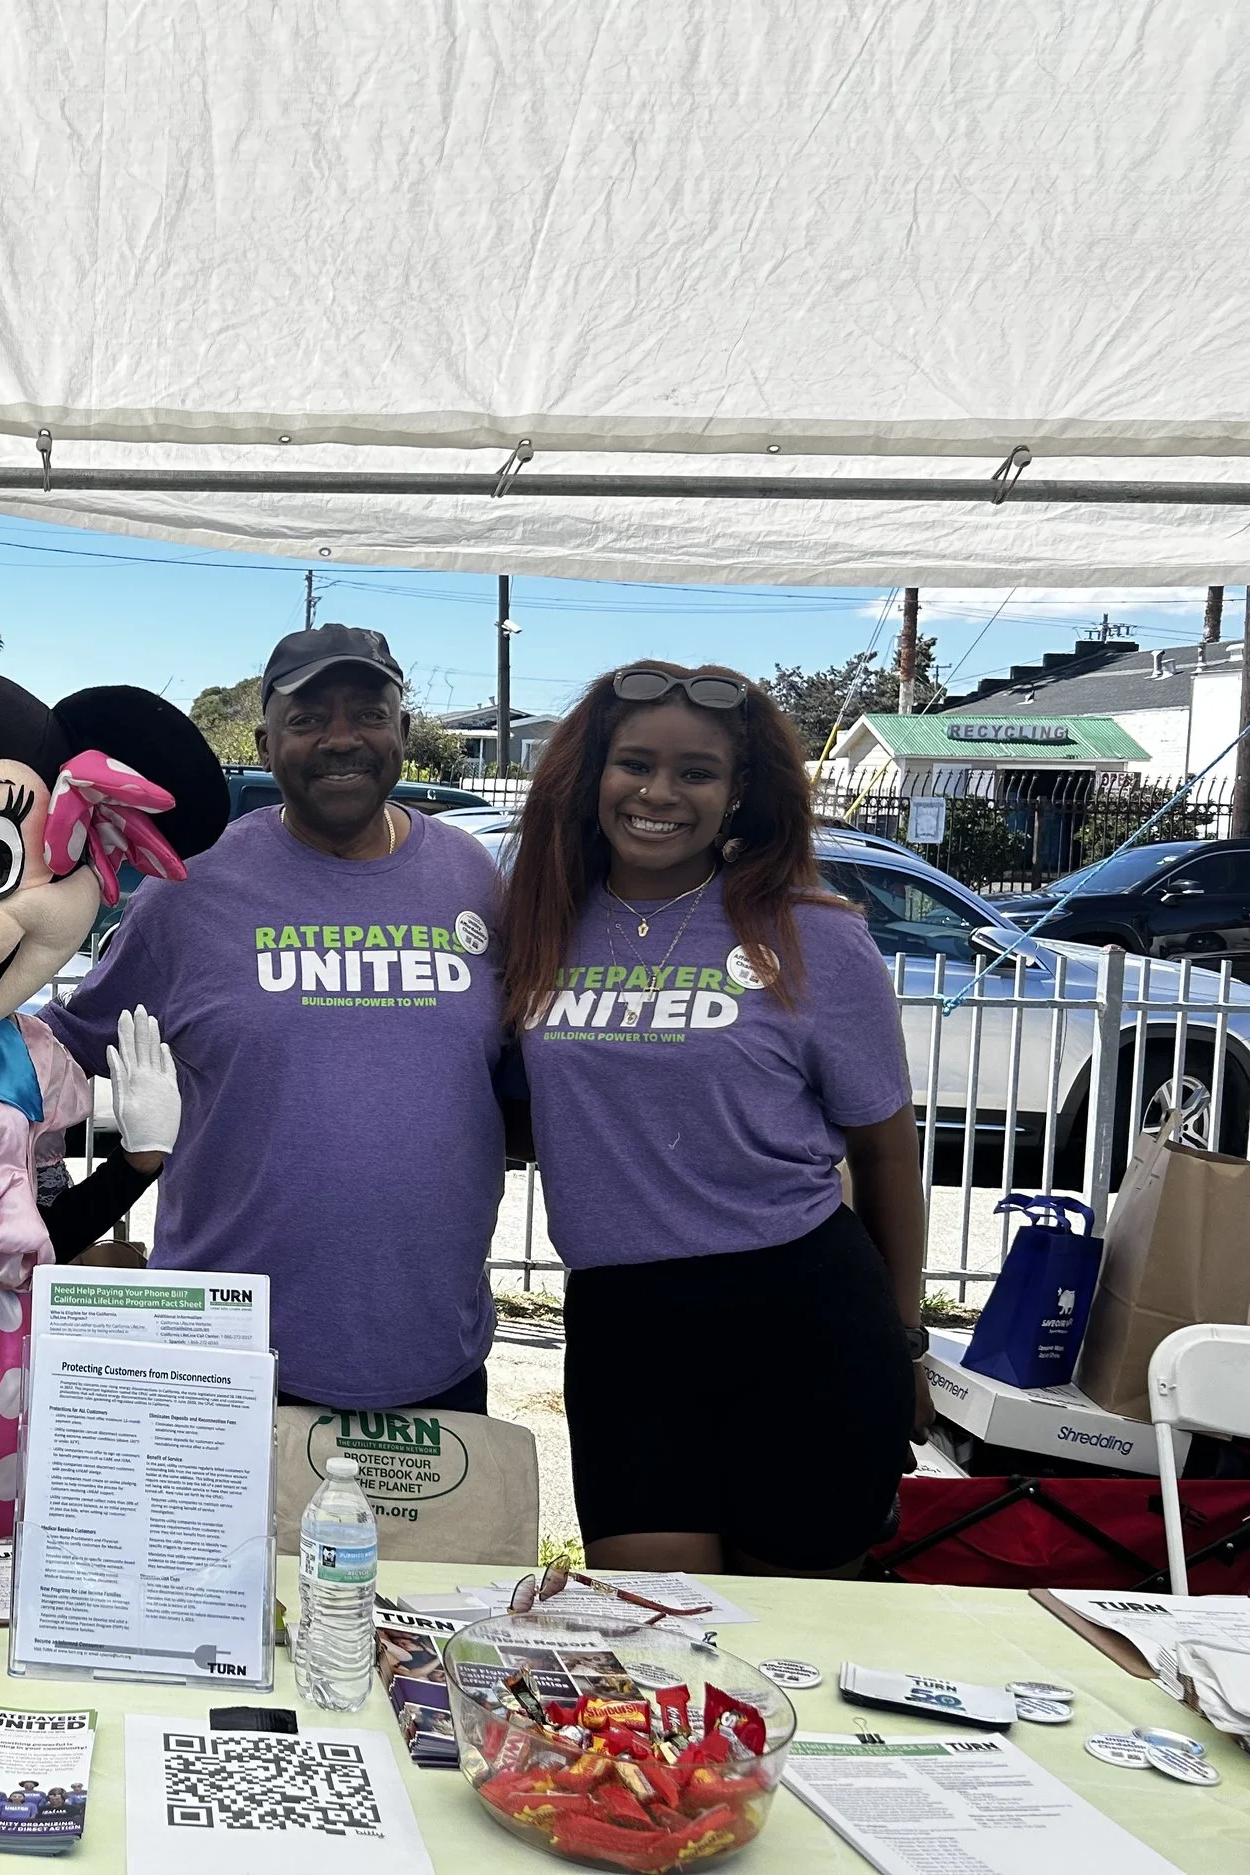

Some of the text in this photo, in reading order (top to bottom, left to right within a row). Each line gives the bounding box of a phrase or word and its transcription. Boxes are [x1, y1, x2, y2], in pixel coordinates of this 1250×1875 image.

[950, 724, 1066, 739] RECYCLING
[257, 949, 471, 992] UNITED
[301, 996, 437, 1007] BUILDING POWER TO WIN
[544, 1031, 686, 1043] BUILDING POWER TO WIN
[54, 1286, 188, 1298] Need Help Paying Your Phone Bill?
[209, 1288, 253, 1303] TURN
[54, 1295, 92, 1304] California
[93, 1296, 124, 1305] LifeLine
[125, 1298, 160, 1307] Program
[161, 1299, 178, 1307] Fact
[179, 1299, 203, 1308] Sheet
[62, 1361, 231, 1384] Protecting Customers from Disconnections
[923, 1367, 968, 1401] nagement
[331, 1409, 441, 1446] TURN
[339, 1439, 439, 1454] THE UTILITY REFORM NETWORK
[1057, 1426, 1135, 1456] Shredding
[398, 1457, 432, 1470] YOUR
[359, 1466, 441, 1483] KETBOOK AND
[378, 1480, 423, 1494] PLANET
[51, 1586, 71, 1594] Programs
[1088, 1600, 1170, 1613] TURN
[376, 1611, 456, 1632] TURN
[533, 1639, 598, 1649] Report
[207, 1662, 247, 1677] TURN
[459, 1665, 477, 1673] The
[912, 1679, 957, 1693] TURN
[586, 1704, 638, 1718] Starburst
[945, 1742, 1002, 1752] TURN
[48, 1824, 81, 1832] ACTION
